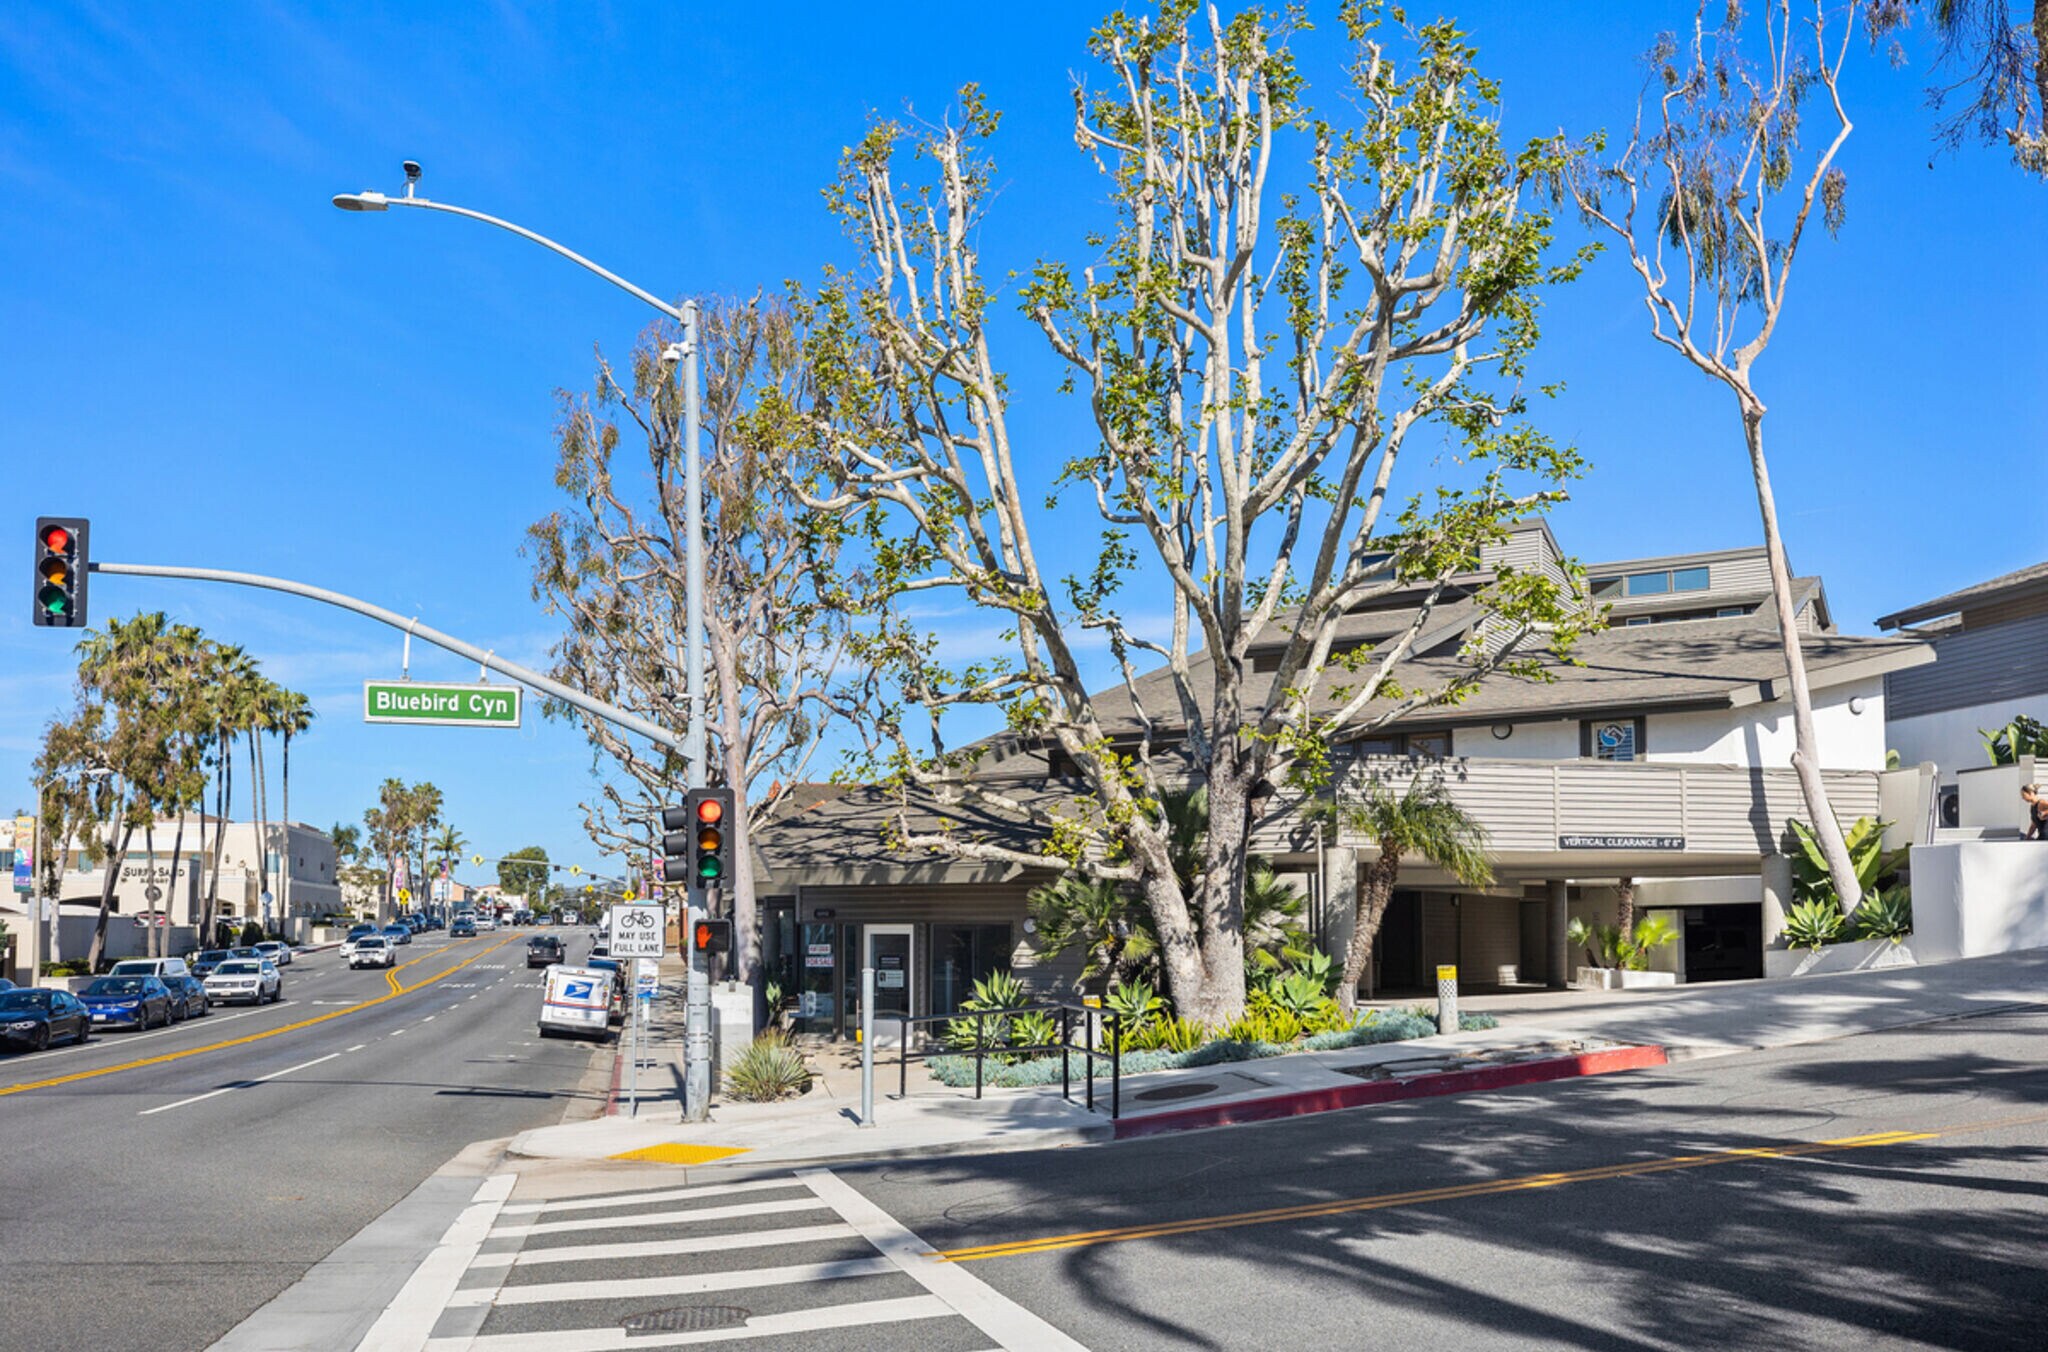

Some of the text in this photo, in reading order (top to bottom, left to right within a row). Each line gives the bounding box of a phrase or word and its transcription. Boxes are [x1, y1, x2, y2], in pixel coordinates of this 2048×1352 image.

[376, 691, 507, 717] Bluebird Cyn
[1564, 837, 1605, 846] VERTICAL
[1606, 838, 1657, 847] CLEARANCE
[158, 867, 185, 877] SAD
[618, 931, 656, 941] MAY USE
[614, 942, 660, 953] FULL LANE
